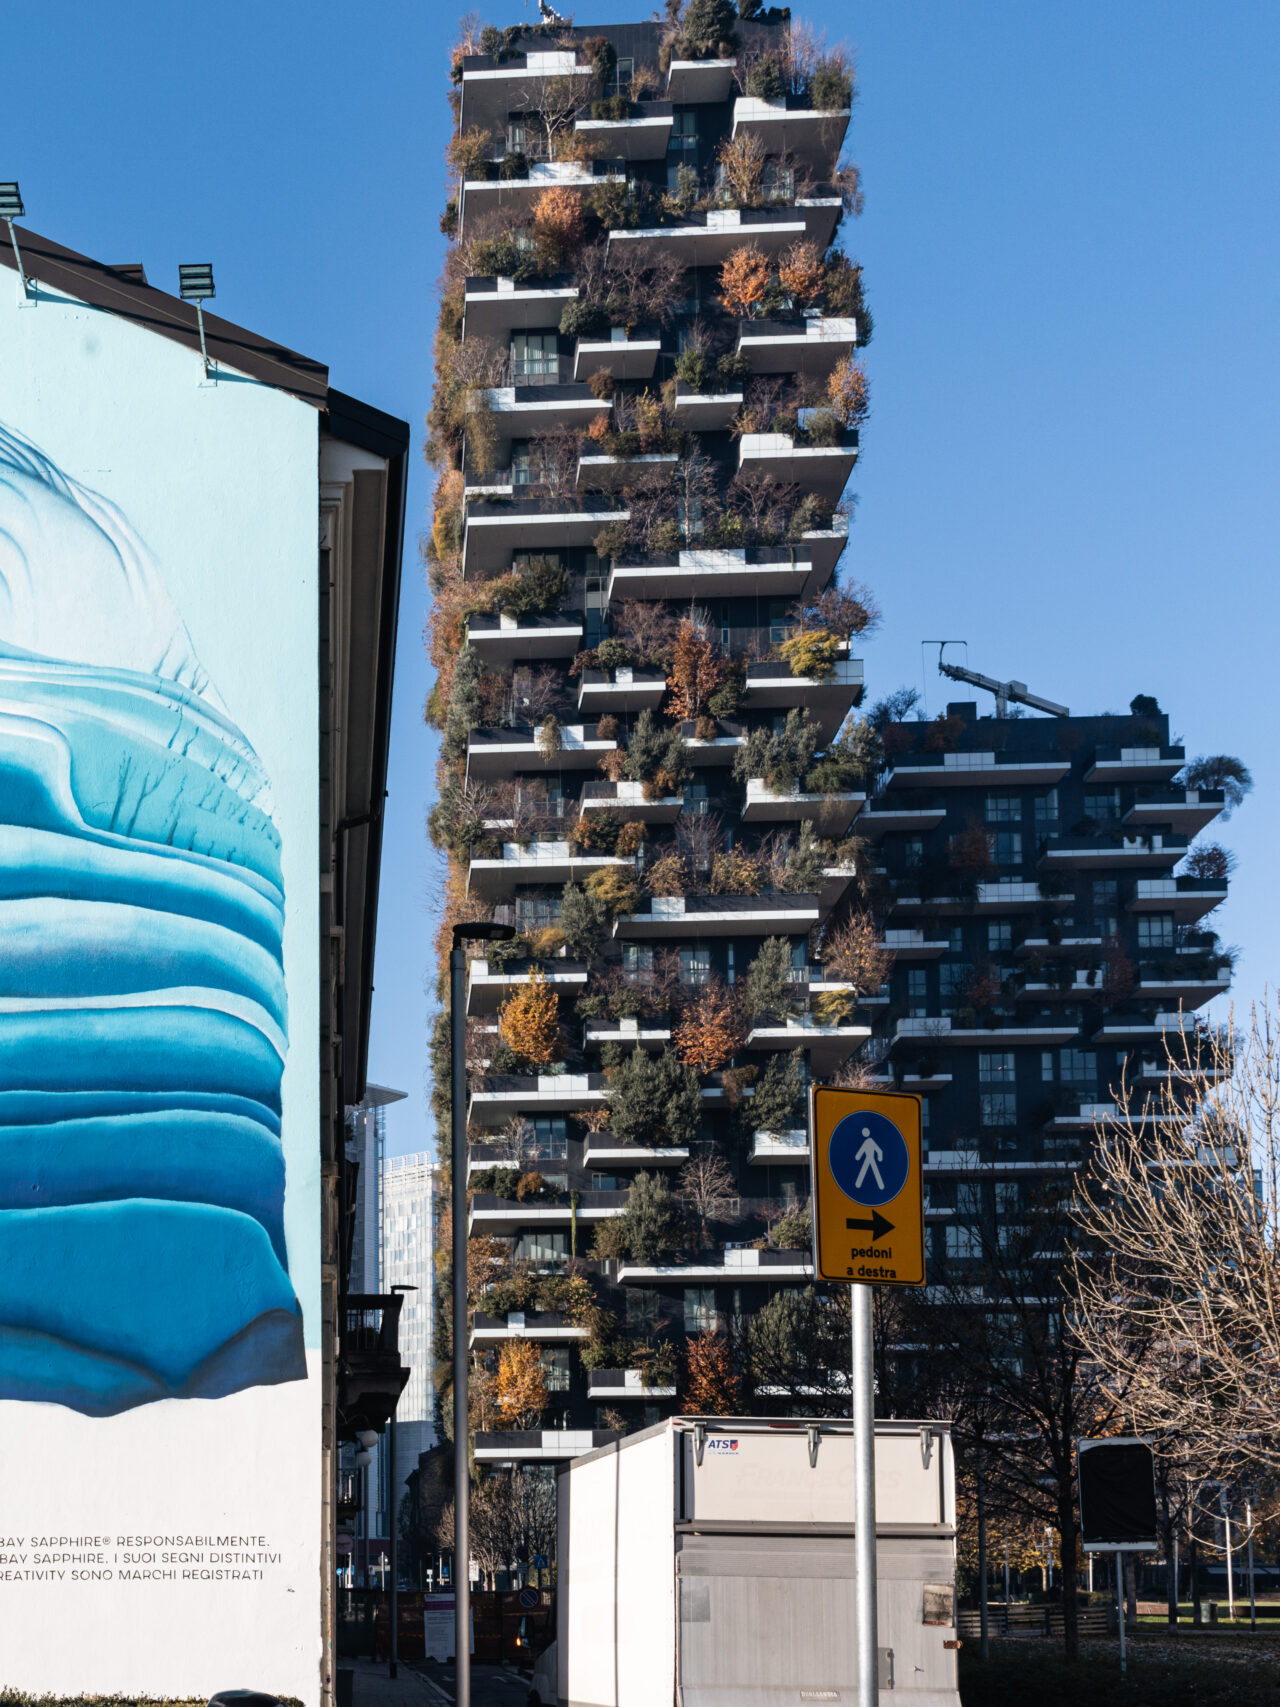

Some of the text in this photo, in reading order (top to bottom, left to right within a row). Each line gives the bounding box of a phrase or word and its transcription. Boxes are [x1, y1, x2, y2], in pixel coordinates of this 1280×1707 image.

[851, 1246, 892, 1260] pedoni
[846, 1264, 896, 1279] a destra
[708, 1440, 729, 1449] ATS
[116, 1535, 270, 1547] RESPONSABILMENTE.
[123, 1552, 156, 1564] SUOI
[161, 1552, 204, 1564] SEGNI
[209, 1552, 281, 1564] DISTINTIVI
[71, 1569, 113, 1581] SONO
[118, 1569, 177, 1581] MARCHI
[182, 1569, 263, 1580] REGISTRATI
